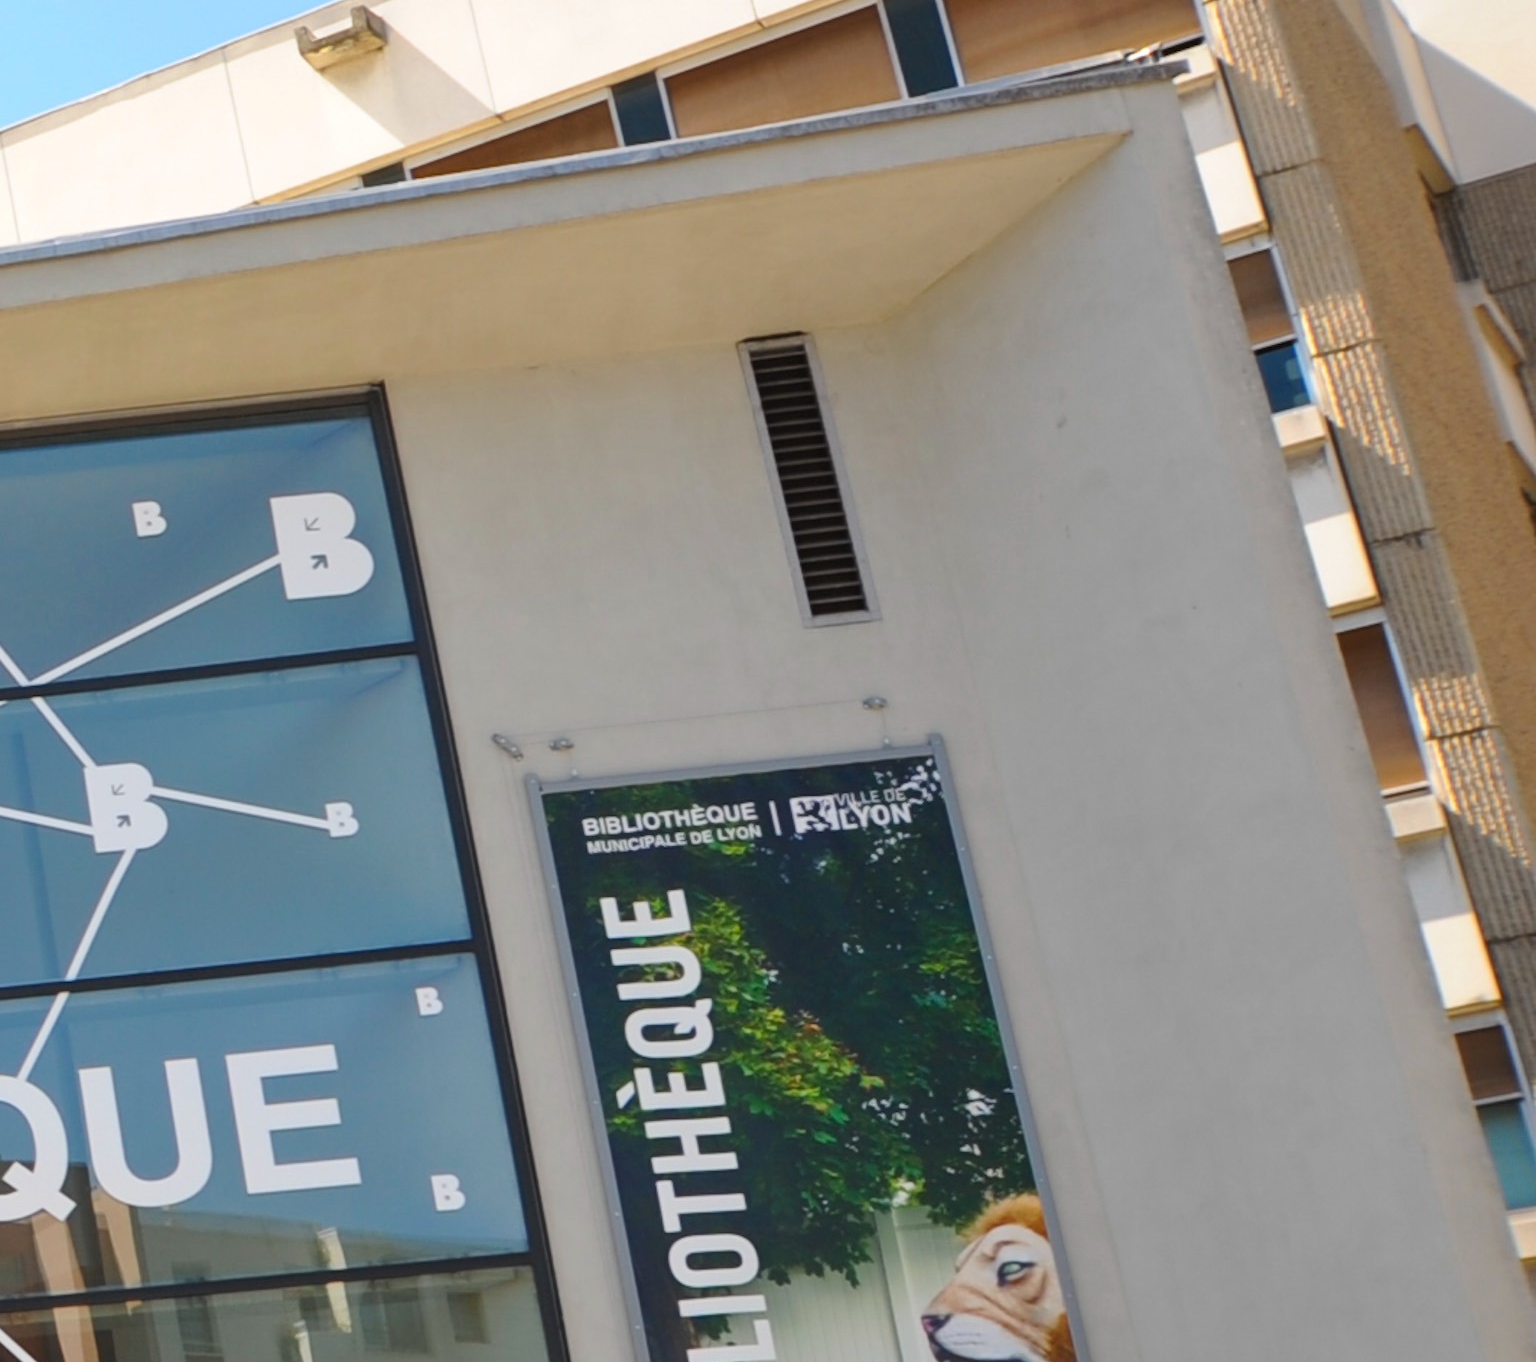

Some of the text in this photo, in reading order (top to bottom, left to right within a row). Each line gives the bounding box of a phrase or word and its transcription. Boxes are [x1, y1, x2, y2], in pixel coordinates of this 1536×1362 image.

[132, 500, 167, 536] B
[269, 492, 374, 600] B
[84, 763, 168, 853] B
[325, 802, 359, 837] B
[582, 803, 758, 836] BIBLIOTHÈQUE
[838, 802, 912, 830] LYON
[586, 824, 762, 854] MUNICIPALE DE LYON
[415, 986, 443, 1015] B
[431, 1175, 466, 1212] B
